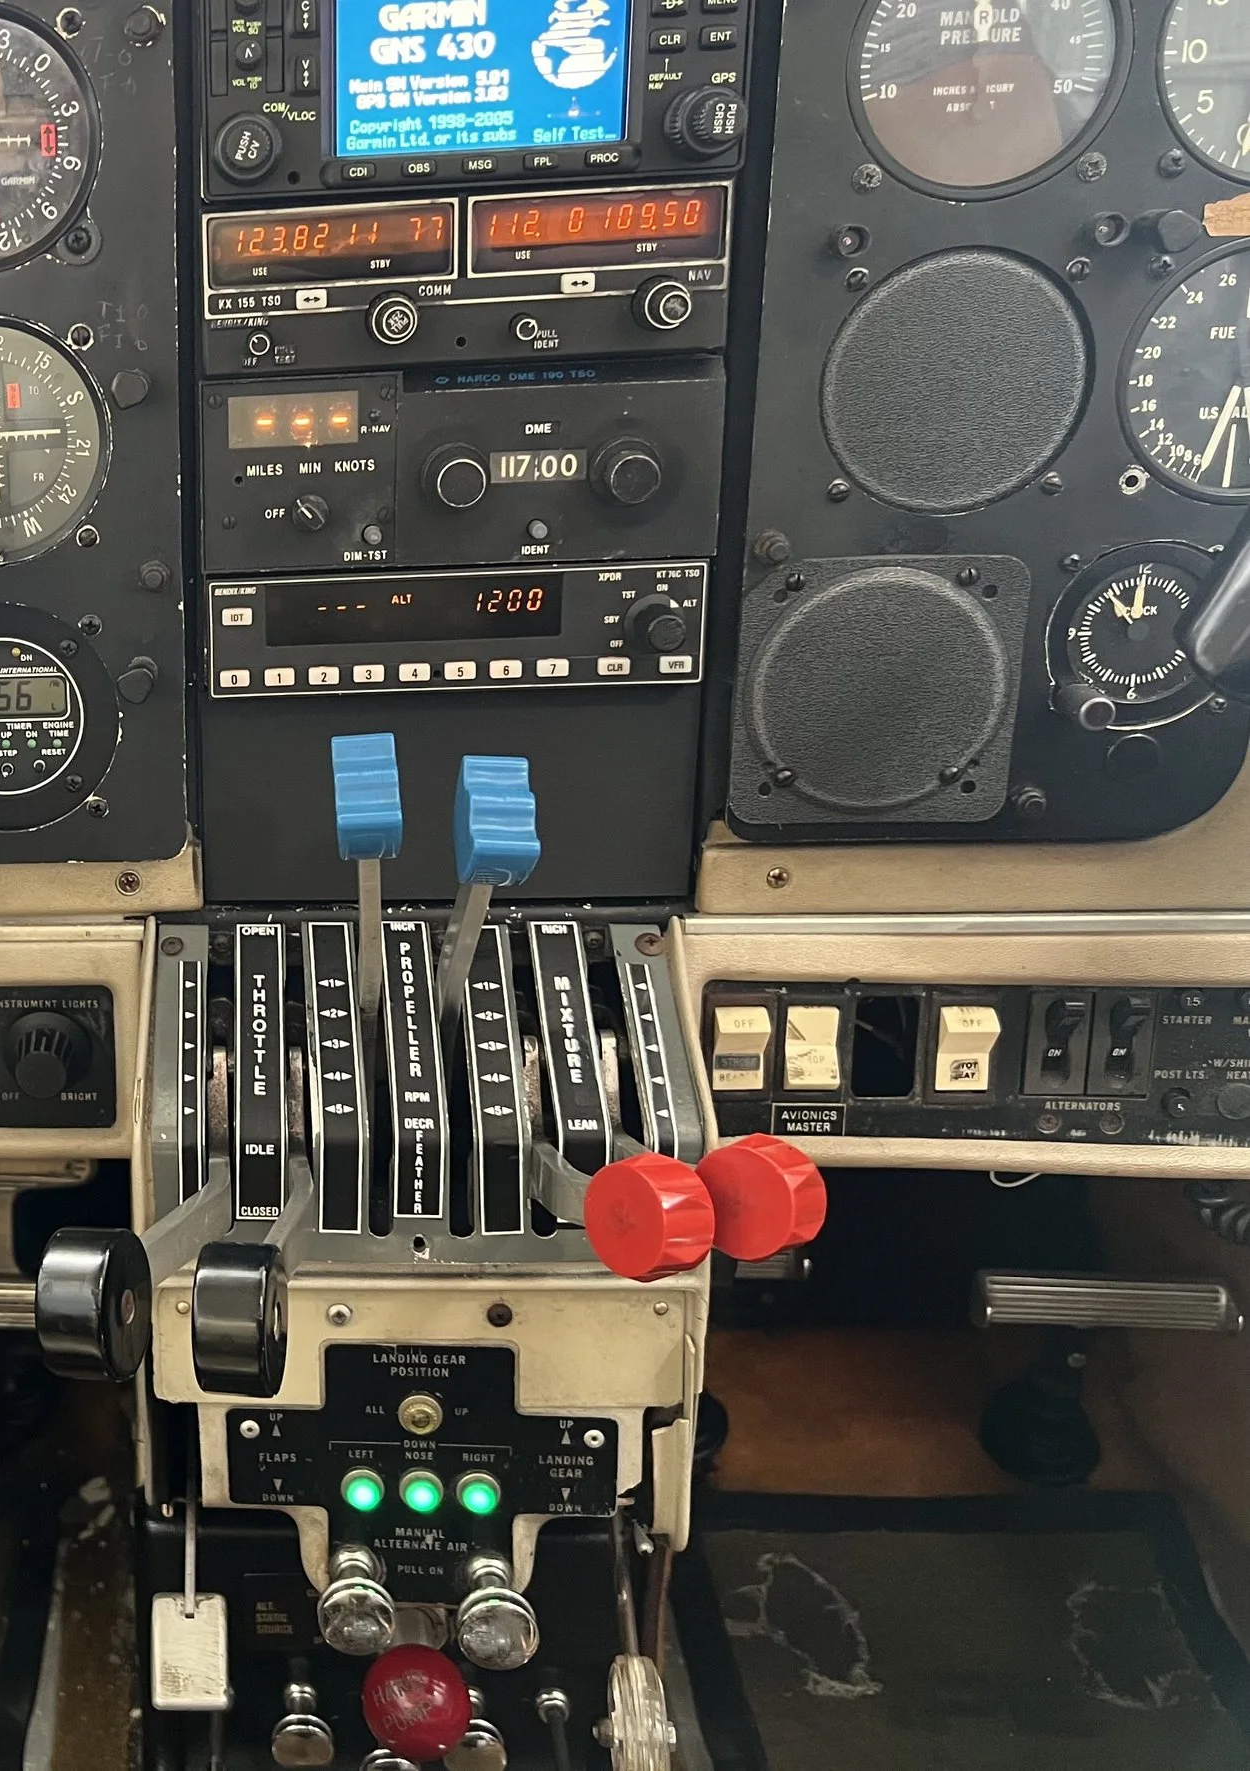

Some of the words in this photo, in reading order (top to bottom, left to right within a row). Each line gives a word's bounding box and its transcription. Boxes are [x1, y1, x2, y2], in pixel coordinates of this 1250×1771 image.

[378, 0, 487, 32] GARMIN
[659, 34, 681, 46] CLR
[710, 31, 732, 42] ENT
[370, 35, 427, 66] GNS
[436, 30, 496, 62] 430
[1181, 38, 1208, 64] 10
[711, 72, 737, 84] GPS
[879, 85, 897, 99] 10
[1053, 80, 1073, 94] 50
[1196, 89, 1214, 114] 5
[349, 117, 423, 137] Copyright
[428, 110, 515, 131] 1998-2005
[346, 132, 397, 151] Garmin
[400, 131, 431, 148] Ltd.
[433, 134, 453, 147] or
[456, 129, 479, 144] its
[482, 127, 517, 143] subs
[533, 127, 567, 144] Self
[349, 166, 368, 177] CDI
[408, 162, 431, 174] OBS
[468, 159, 493, 172] MSG
[533, 156, 553, 168] FPL
[590, 153, 619, 165] PROC
[0, 175, 36, 187] GARMIN
[604, 198, 701, 231] 109.50
[236, 222, 330, 254] 123.82
[636, 242, 658, 253] STBY
[515, 250, 531, 260] USE
[370, 258, 391, 269] STBY
[252, 267, 268, 277] USE
[688, 268, 712, 282] NAV
[1218, 273, 1237, 286] 26
[418, 284, 452, 297] COMM
[218, 298, 232, 310] KX
[237, 296, 256, 309] 155
[261, 295, 281, 307] TSO
[1157, 315, 1177, 329] 22
[533, 338, 560, 350] IDENT
[457, 372, 501, 384] NARCO
[508, 371, 535, 382] DME
[360, 424, 391, 434] R-NAV
[525, 422, 552, 435] DME
[246, 463, 283, 477] MILES
[299, 462, 322, 475] MIN
[334, 458, 375, 473] KNOTS
[264, 508, 286, 519] OFF
[343, 549, 388, 562] DIM-TST
[521, 544, 550, 556] IDENT
[598, 572, 622, 582] XPDR
[391, 593, 413, 606] ALT
[476, 587, 544, 613] 1200
[621, 590, 636, 599] TST
[682, 598, 697, 608] ALT
[230, 612, 244, 623] IDT
[603, 615, 620, 624] SBY
[609, 639, 624, 649] OFF
[0, 665, 58, 675] INTERNATIONAL
[606, 662, 624, 673] CLR
[668, 660, 685, 670] VFR
[5, 722, 32, 730] TIMER
[42, 721, 75, 730] ENGINE
[0, 731, 12, 739] UP
[25, 730, 38, 739] DN
[48, 729, 69, 738] TIME
[41, 748, 66, 756] RESET
[241, 926, 275, 937] OPEN
[62, 999, 99, 1009] LIGHTS
[399, 941, 423, 1078] PROPELLER
[1161, 1015, 1212, 1025] STARTER
[252, 973, 268, 1096] THROTTLE
[553, 976, 583, 1084] MIXTURE
[1, 1092, 20, 1101] OFF
[60, 1092, 98, 1101] BRIGHT
[404, 1091, 430, 1103] RPM
[1044, 1101, 1121, 1112] ALTERNATORS
[781, 1110, 838, 1121] AVIONICS
[404, 1117, 435, 1129] DECR
[567, 1119, 598, 1131] LEAN
[786, 1121, 831, 1133] MASTER
[245, 1144, 275, 1156] IDLE
[413, 1130, 424, 1214] FEATHER
[240, 1206, 280, 1217] CLOSED
[372, 1352, 429, 1365] LANDING
[433, 1353, 467, 1365] GEAR
[390, 1366, 450, 1378] POSITION
[269, 1412, 284, 1422] UP
[365, 1405, 385, 1415] ALL
[454, 1407, 469, 1417] UP
[559, 1419, 575, 1430] UP
[403, 1438, 437, 1450] DOWN
[258, 1451, 298, 1465] FLAPS
[348, 1449, 374, 1460] LEFT
[404, 1450, 434, 1462] NOSE
[462, 1452, 496, 1464] RIGHT
[537, 1454, 595, 1467] LANDING
[549, 1466, 583, 1479] GEAR
[262, 1492, 295, 1503] DOWN
[548, 1502, 582, 1514] DOWN
[395, 1527, 445, 1539] MANUAL
[373, 1538, 443, 1551] ALTERNATE
[447, 1540, 468, 1552] AIR
[397, 1564, 427, 1575] PULL
[429, 1564, 444, 1575] ON
